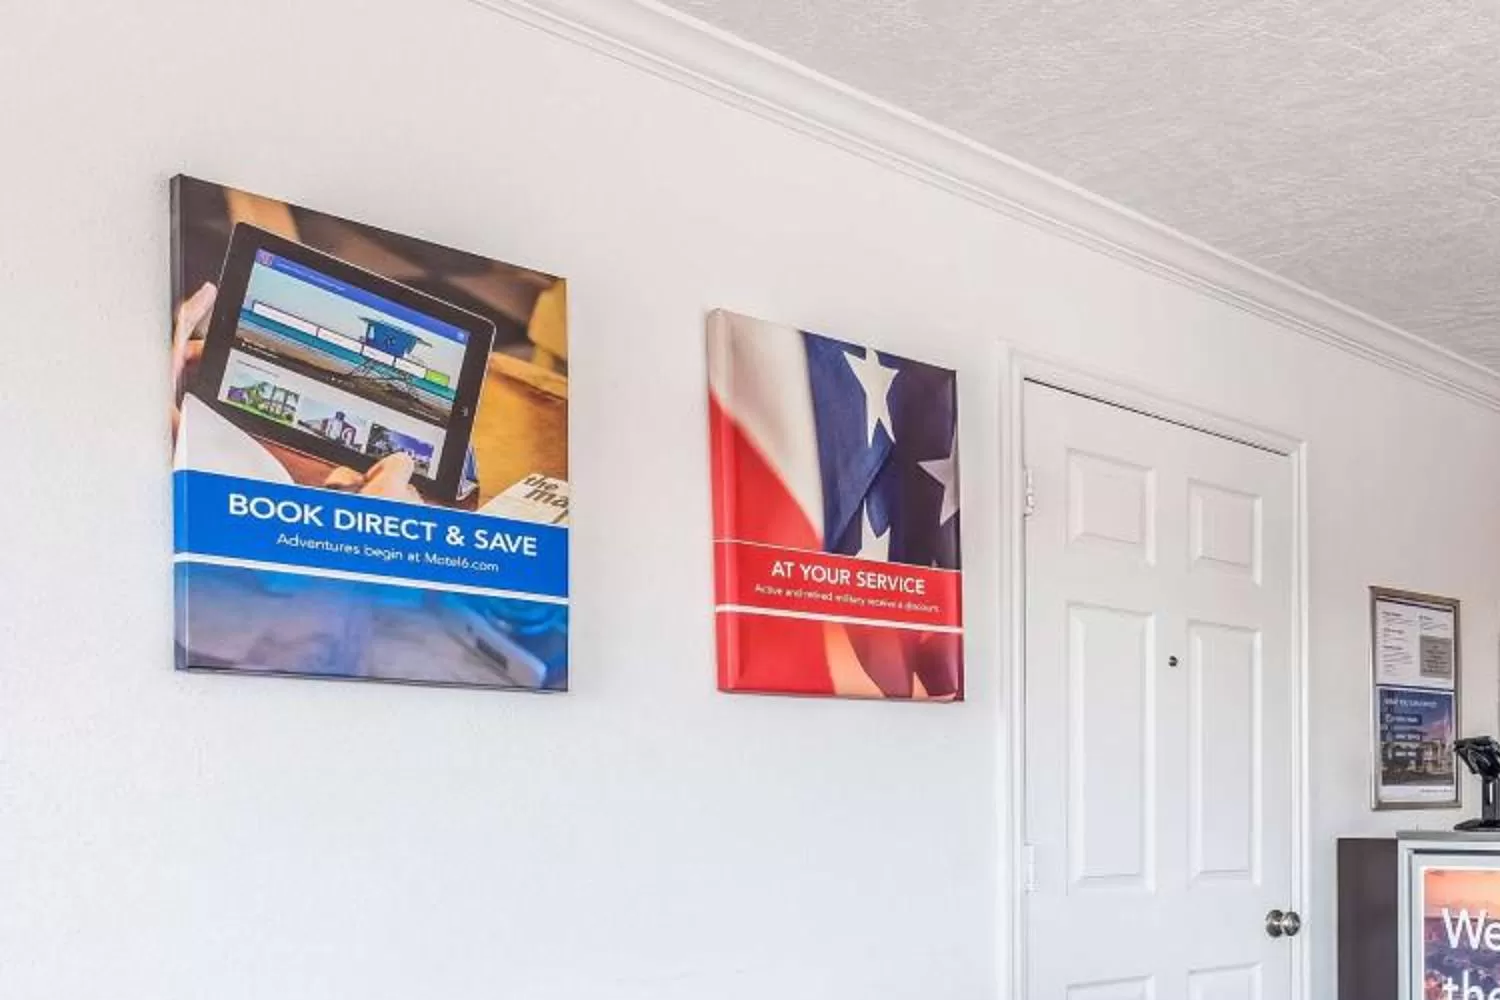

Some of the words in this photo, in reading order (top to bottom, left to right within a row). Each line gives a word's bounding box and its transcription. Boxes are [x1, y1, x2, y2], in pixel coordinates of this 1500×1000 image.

[228, 493, 324, 528] BOOK
[334, 507, 438, 542] DIRECT
[446, 525, 466, 548] &
[473, 528, 538, 557] SAVE
[275, 532, 361, 556] Adventures
[363, 543, 404, 562] begin
[407, 551, 422, 563] at
[424, 551, 500, 573] Motel6.com
[755, 583, 783, 596] Active
[785, 588, 801, 598] and
[802, 588, 833, 602] retired
[835, 593, 866, 607] military
[771, 560, 796, 578] AT
[799, 563, 851, 586] YOUR
[856, 571, 926, 595] SERVICE
